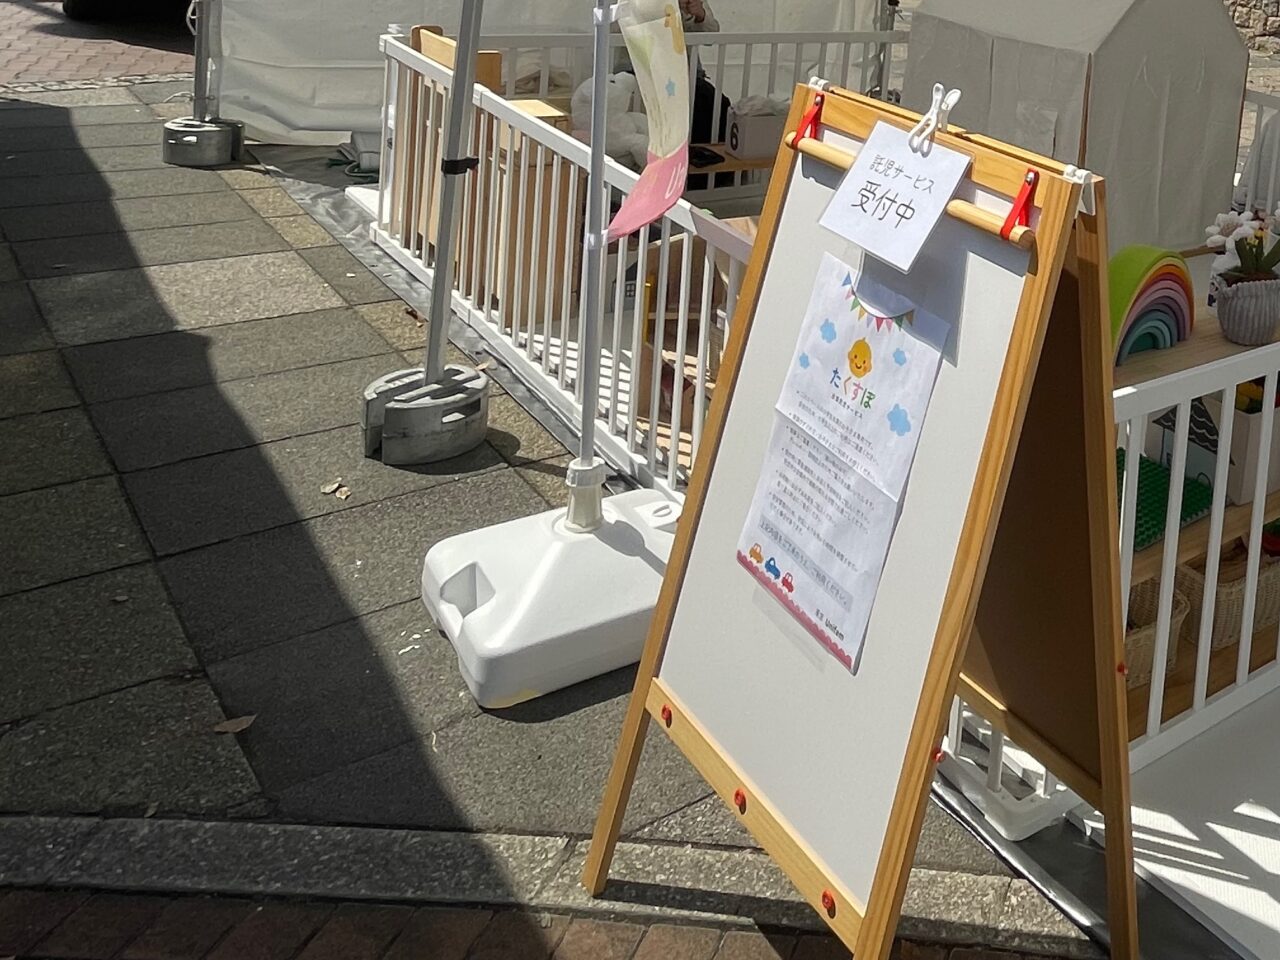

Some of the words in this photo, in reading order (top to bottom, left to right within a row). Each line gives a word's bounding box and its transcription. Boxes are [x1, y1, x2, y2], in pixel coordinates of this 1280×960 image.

[869, 154, 936, 194] 託児サービス
[851, 180, 916, 229] 受付中
